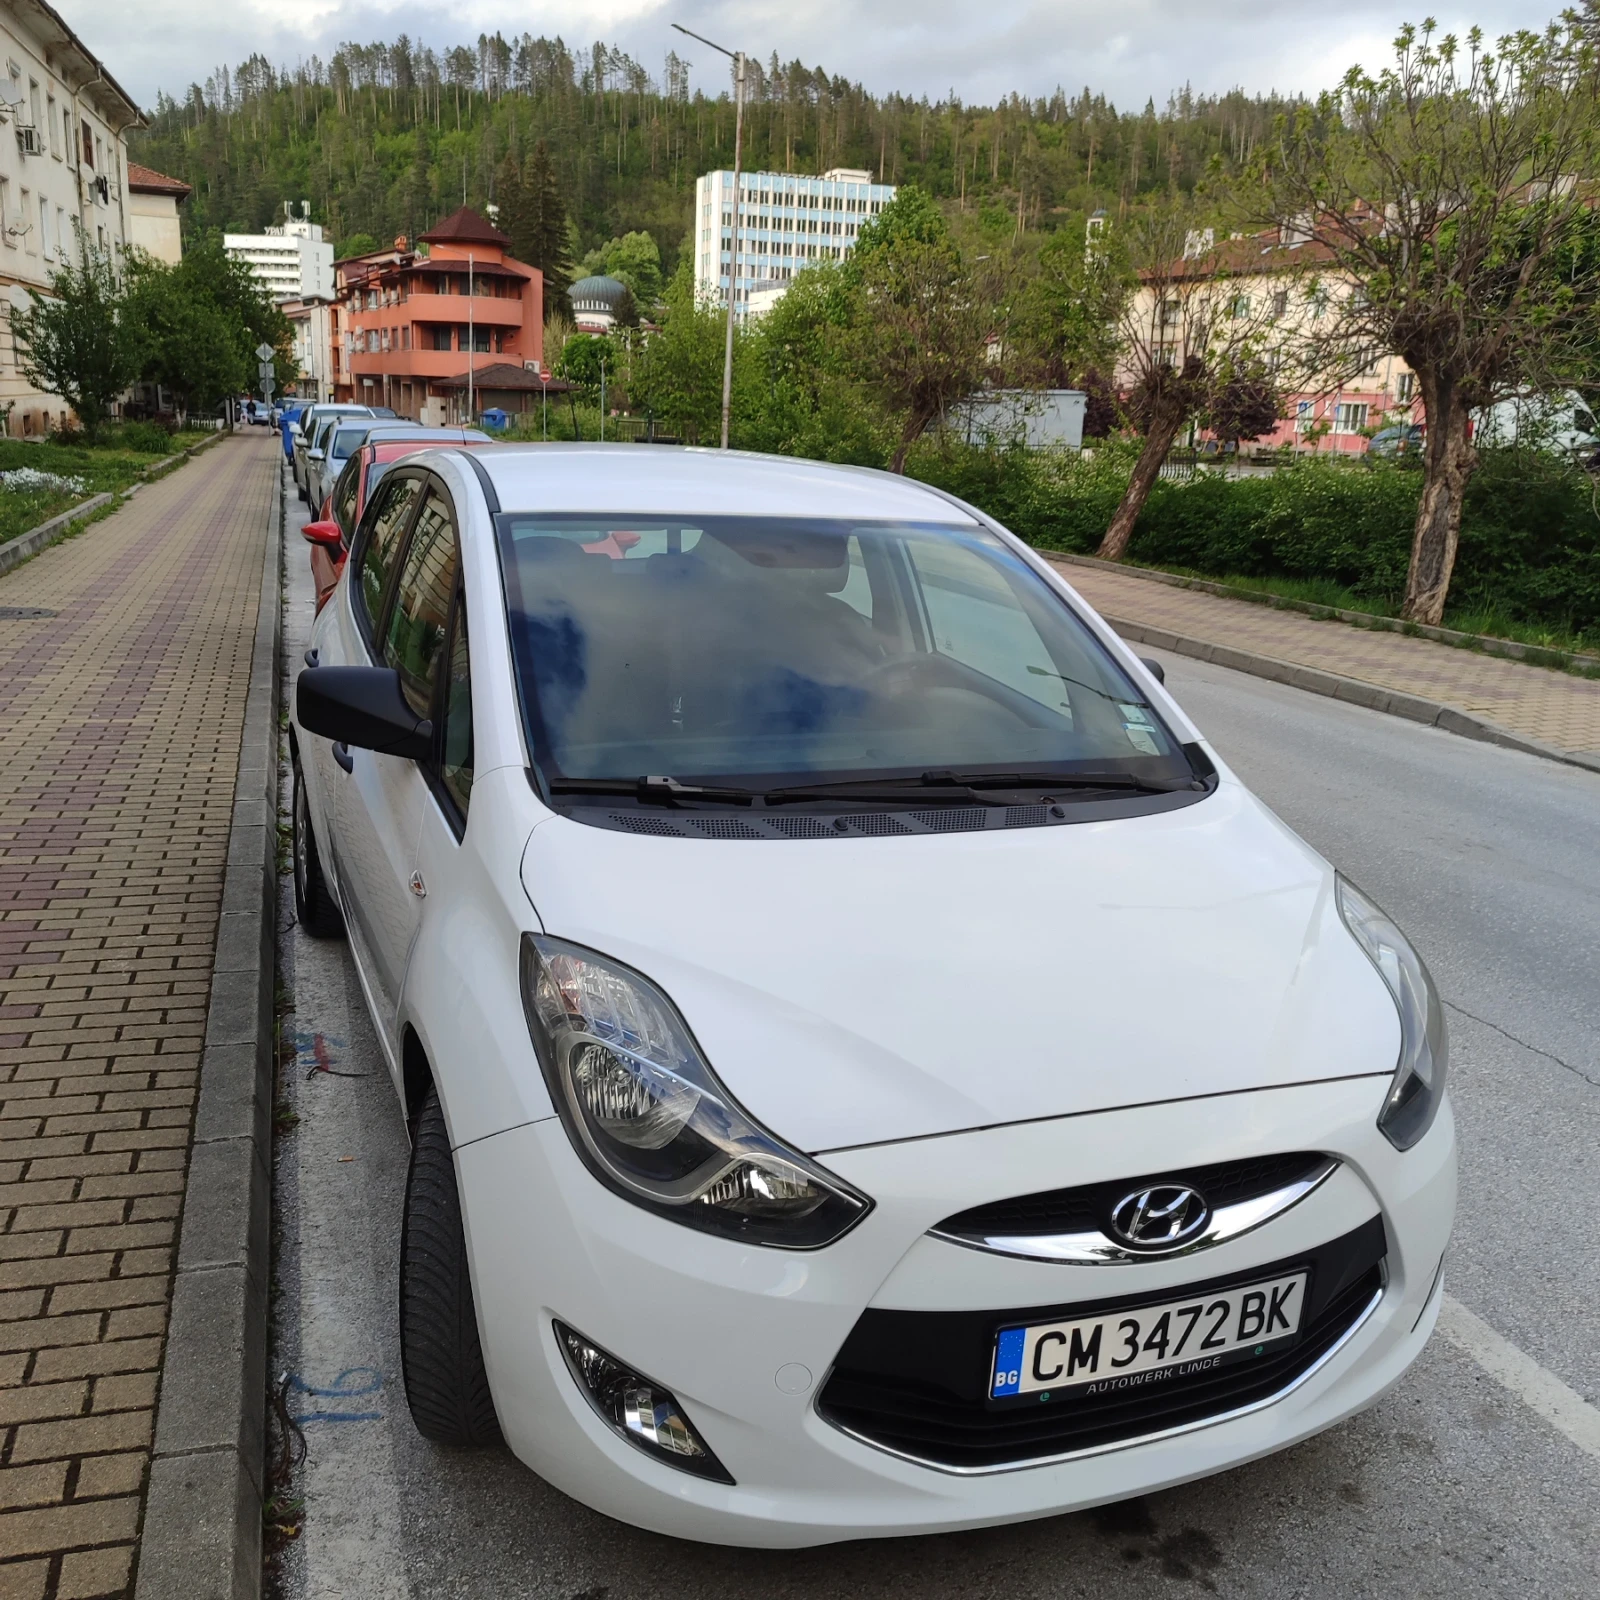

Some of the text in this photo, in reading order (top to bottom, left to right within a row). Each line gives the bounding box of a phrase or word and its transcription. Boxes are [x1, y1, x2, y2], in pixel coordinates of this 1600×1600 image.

[1032, 1281, 1297, 1382] CM 3472 BK
[995, 1370, 1018, 1387] BG
[1086, 1356, 1222, 1395] AUTOWERK LINDE
